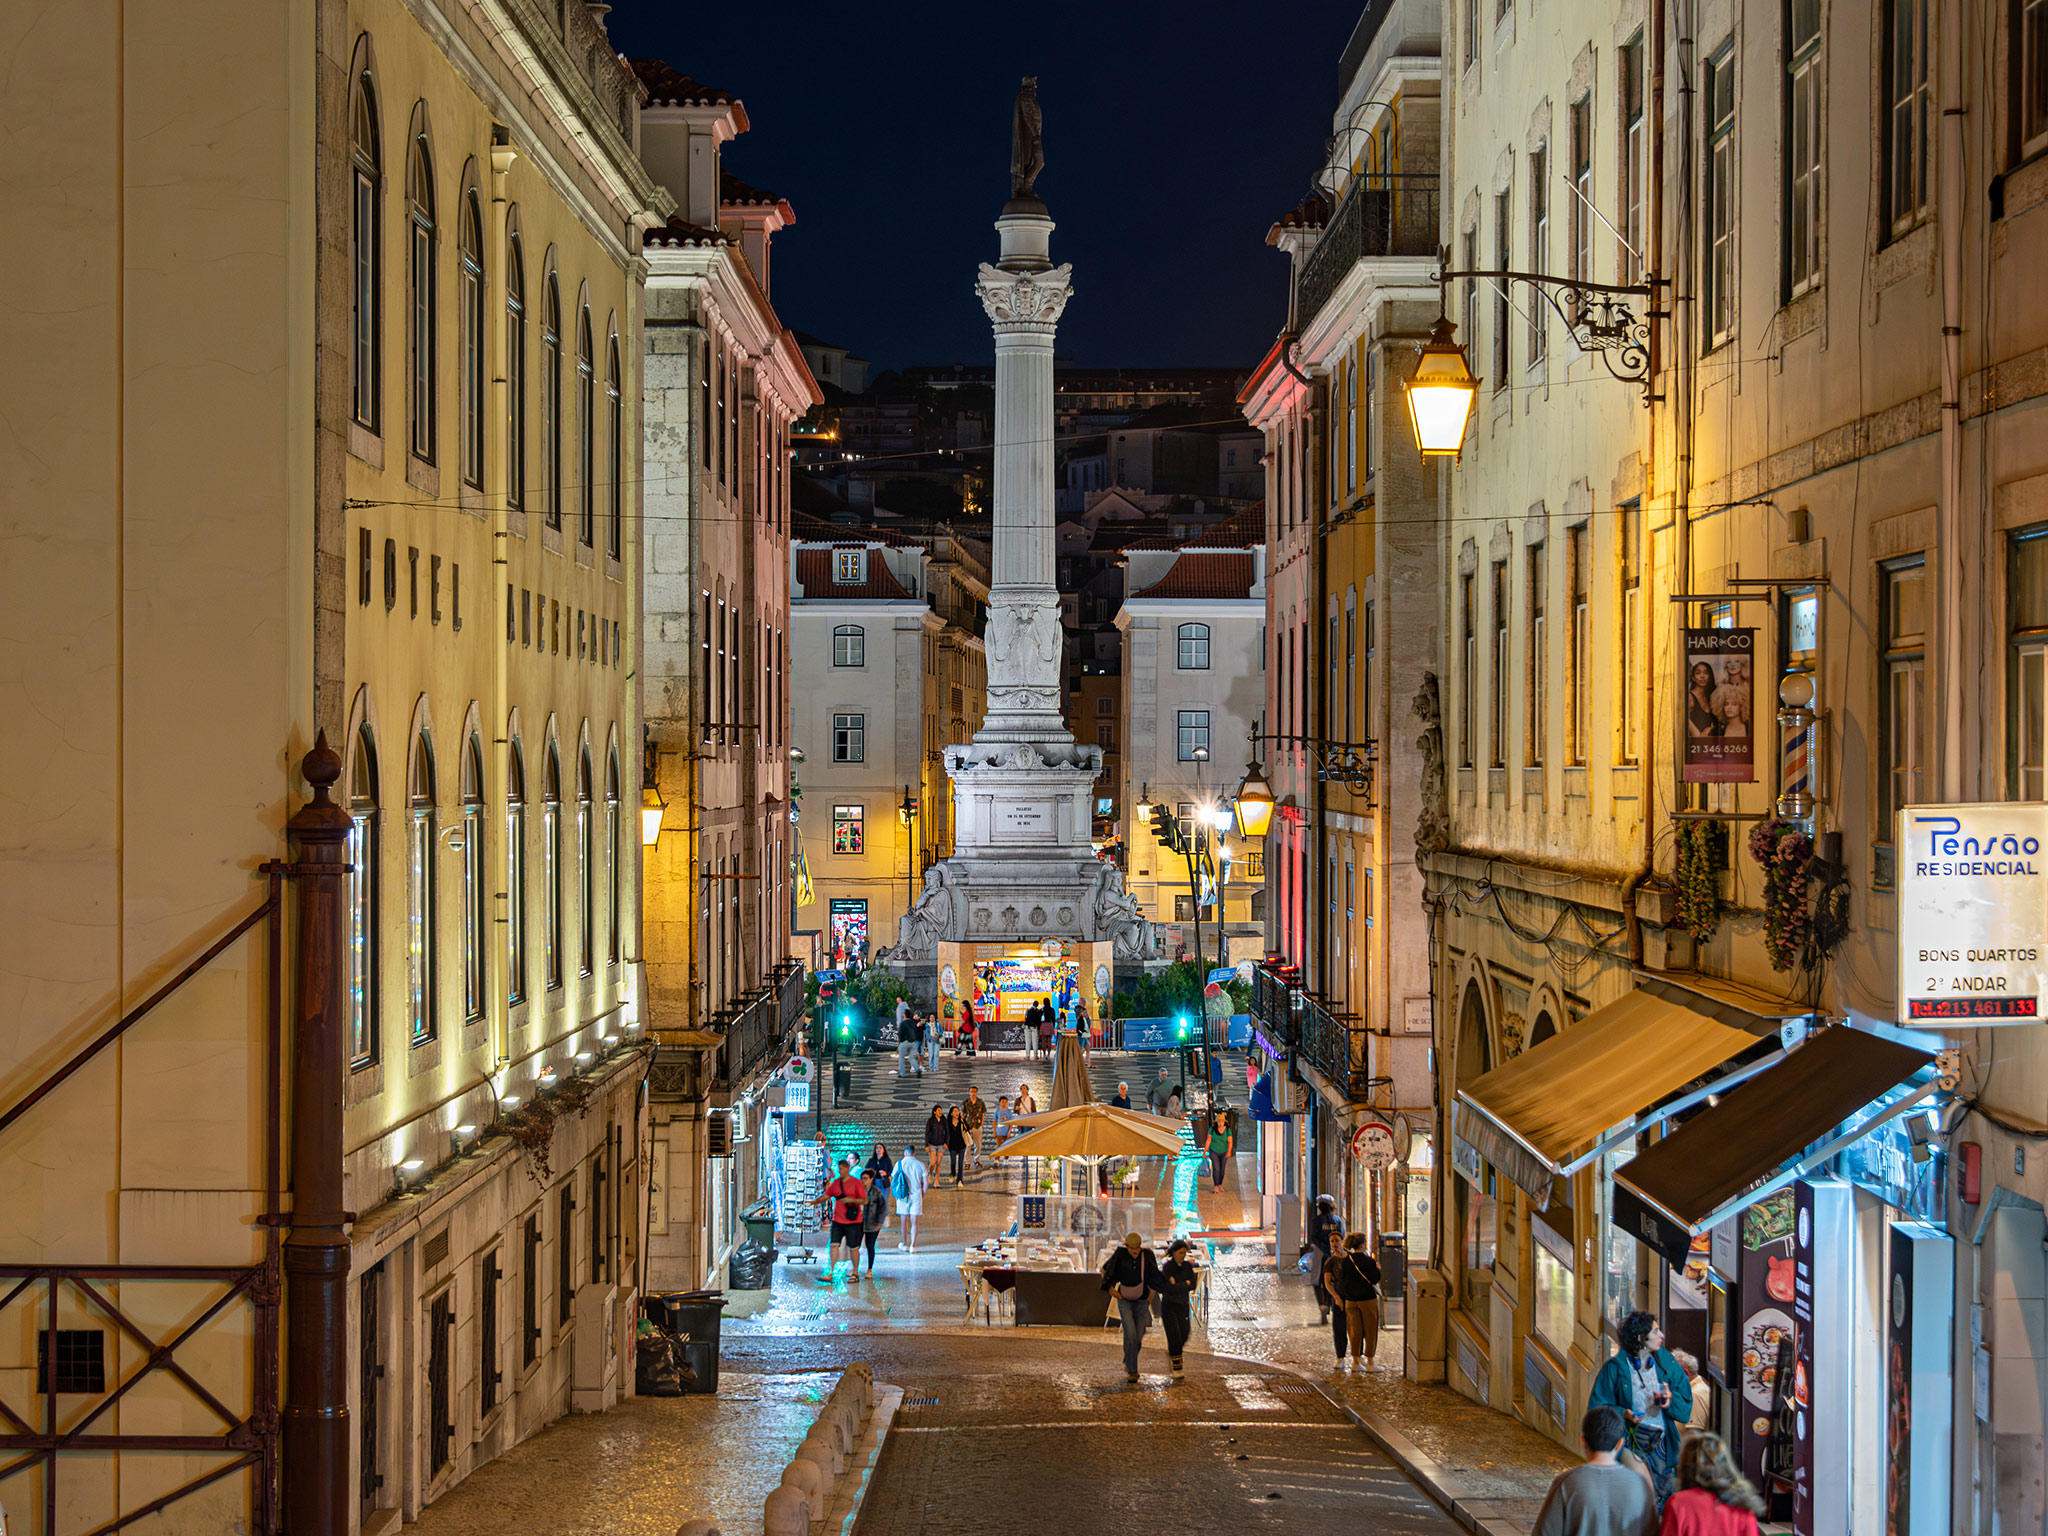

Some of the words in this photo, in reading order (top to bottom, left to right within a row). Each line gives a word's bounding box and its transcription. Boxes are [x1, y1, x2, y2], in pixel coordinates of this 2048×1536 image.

[359, 526, 463, 632] HOTEL
[506, 583, 621, 670] AMERICANO
[1690, 745, 1700, 754] 21
[1703, 745, 1721, 754] 346
[1724, 744, 1748, 754] 8268
[1915, 816, 2040, 857] Pensão
[1916, 861, 2039, 877] RESIDENCIAL
[1919, 949, 1960, 962] BONS
[1967, 948, 2038, 962] QUARTOS
[1952, 976, 2007, 991] ANDAR
[1974, 1001, 2002, 1016] 461
[2008, 1000, 2036, 1016] 133
